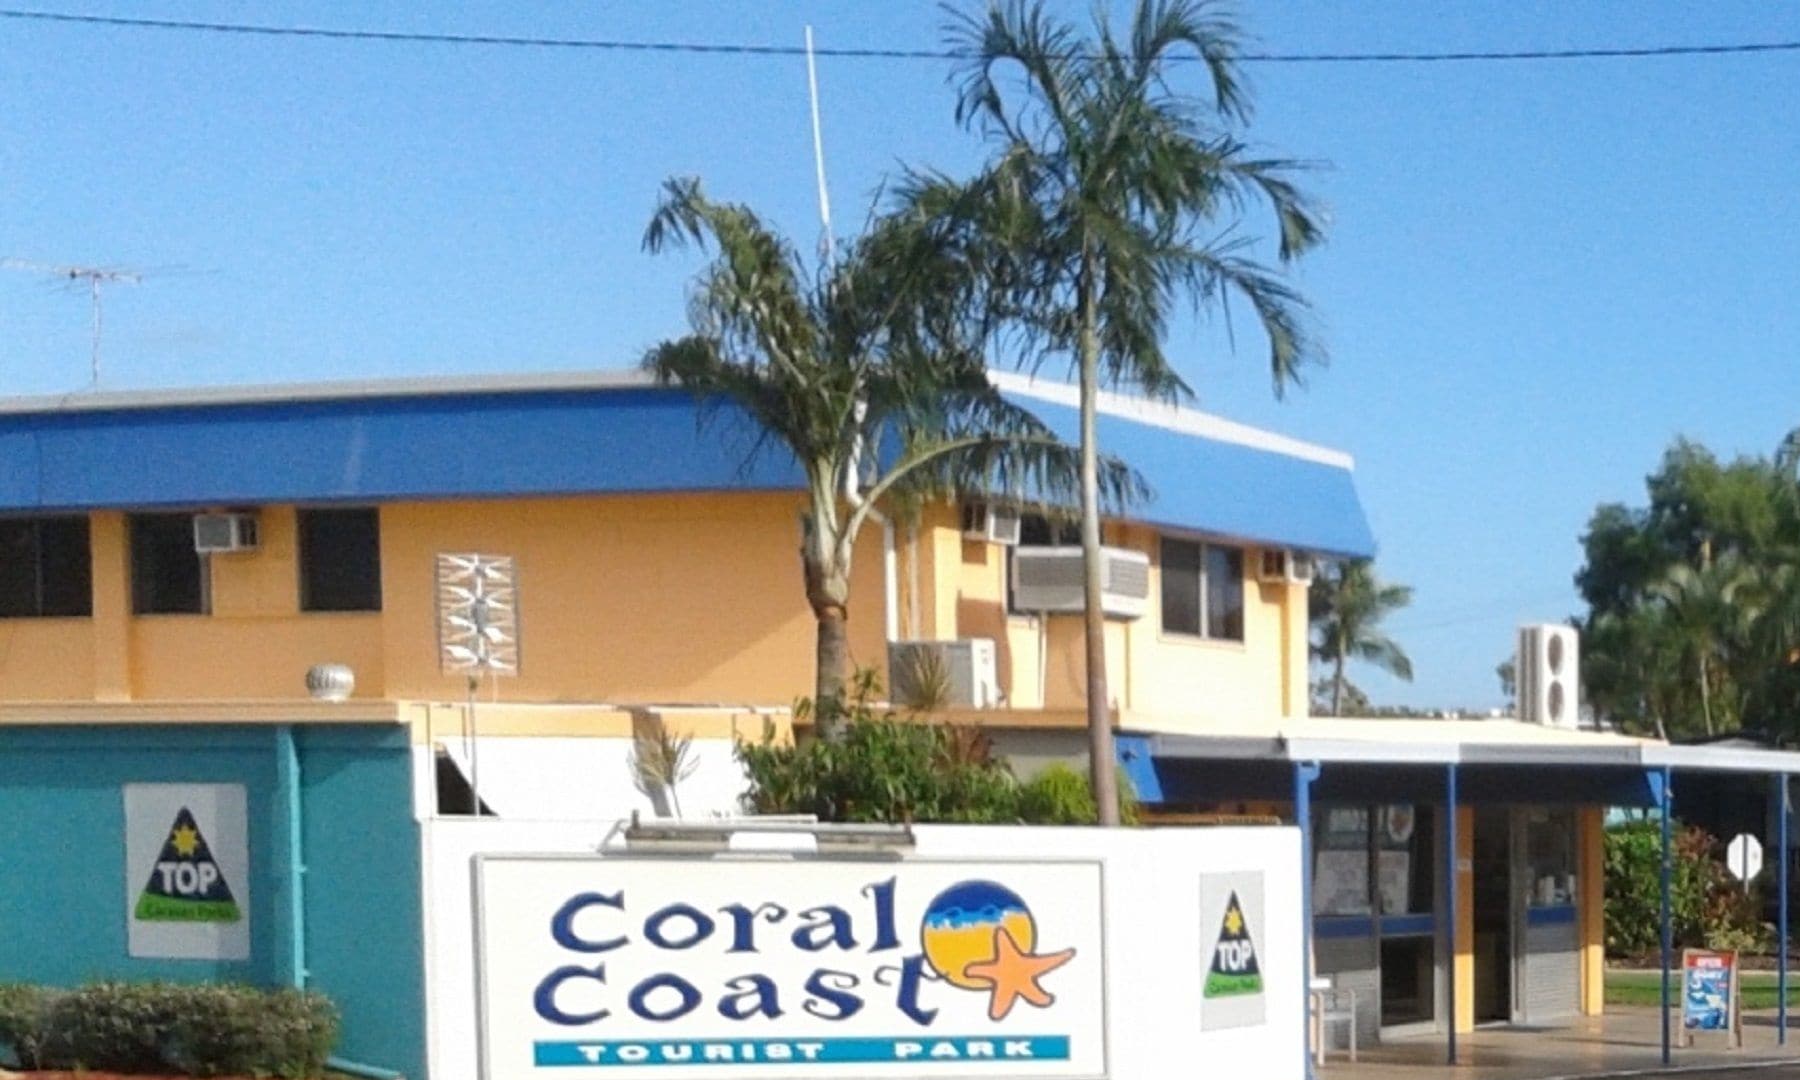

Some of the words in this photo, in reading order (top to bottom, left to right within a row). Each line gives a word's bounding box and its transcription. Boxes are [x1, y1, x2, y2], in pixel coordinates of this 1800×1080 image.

[157, 861, 218, 895] TOP
[550, 875, 903, 954] Coral
[1217, 939, 1252, 972] TOP
[533, 954, 946, 1026] Coast
[577, 1040, 824, 1064] TOURIST
[894, 1039, 1035, 1060] PARK
